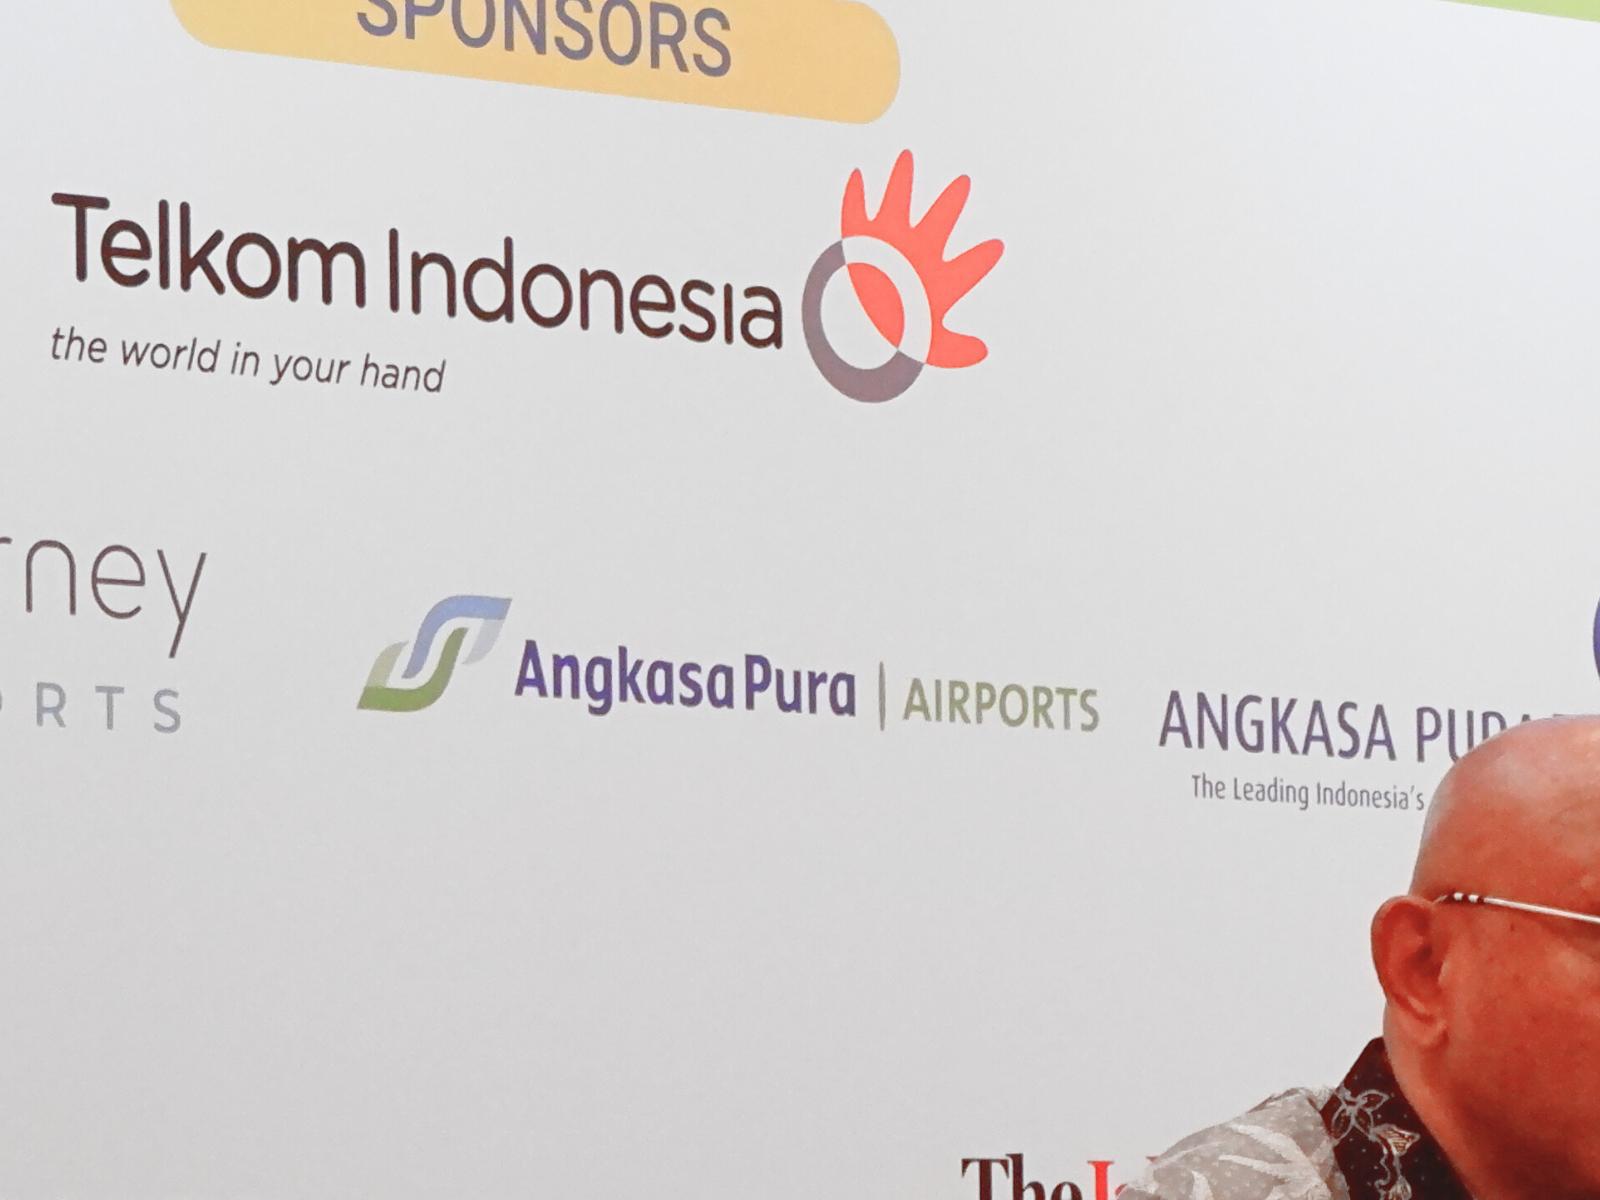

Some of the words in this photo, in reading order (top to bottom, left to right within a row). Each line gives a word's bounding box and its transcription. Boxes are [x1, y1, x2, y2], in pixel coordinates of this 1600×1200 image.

[357, 0, 731, 77] SPONSORS
[51, 193, 366, 308] Telkom
[389, 228, 783, 350] Indonesia
[51, 326, 108, 364] the
[121, 337, 222, 373] world
[231, 342, 260, 378] in
[270, 354, 352, 385] your
[360, 353, 447, 393] hand
[0, 537, 207, 658] ney
[0, 682, 181, 734] RTS
[903, 678, 1100, 733] AIRPORTS
[1159, 690, 1397, 762] ANGKASA
[1192, 773, 1226, 800] The
[1233, 777, 1309, 811] Leading
[1316, 781, 1425, 811] Indonesia's
